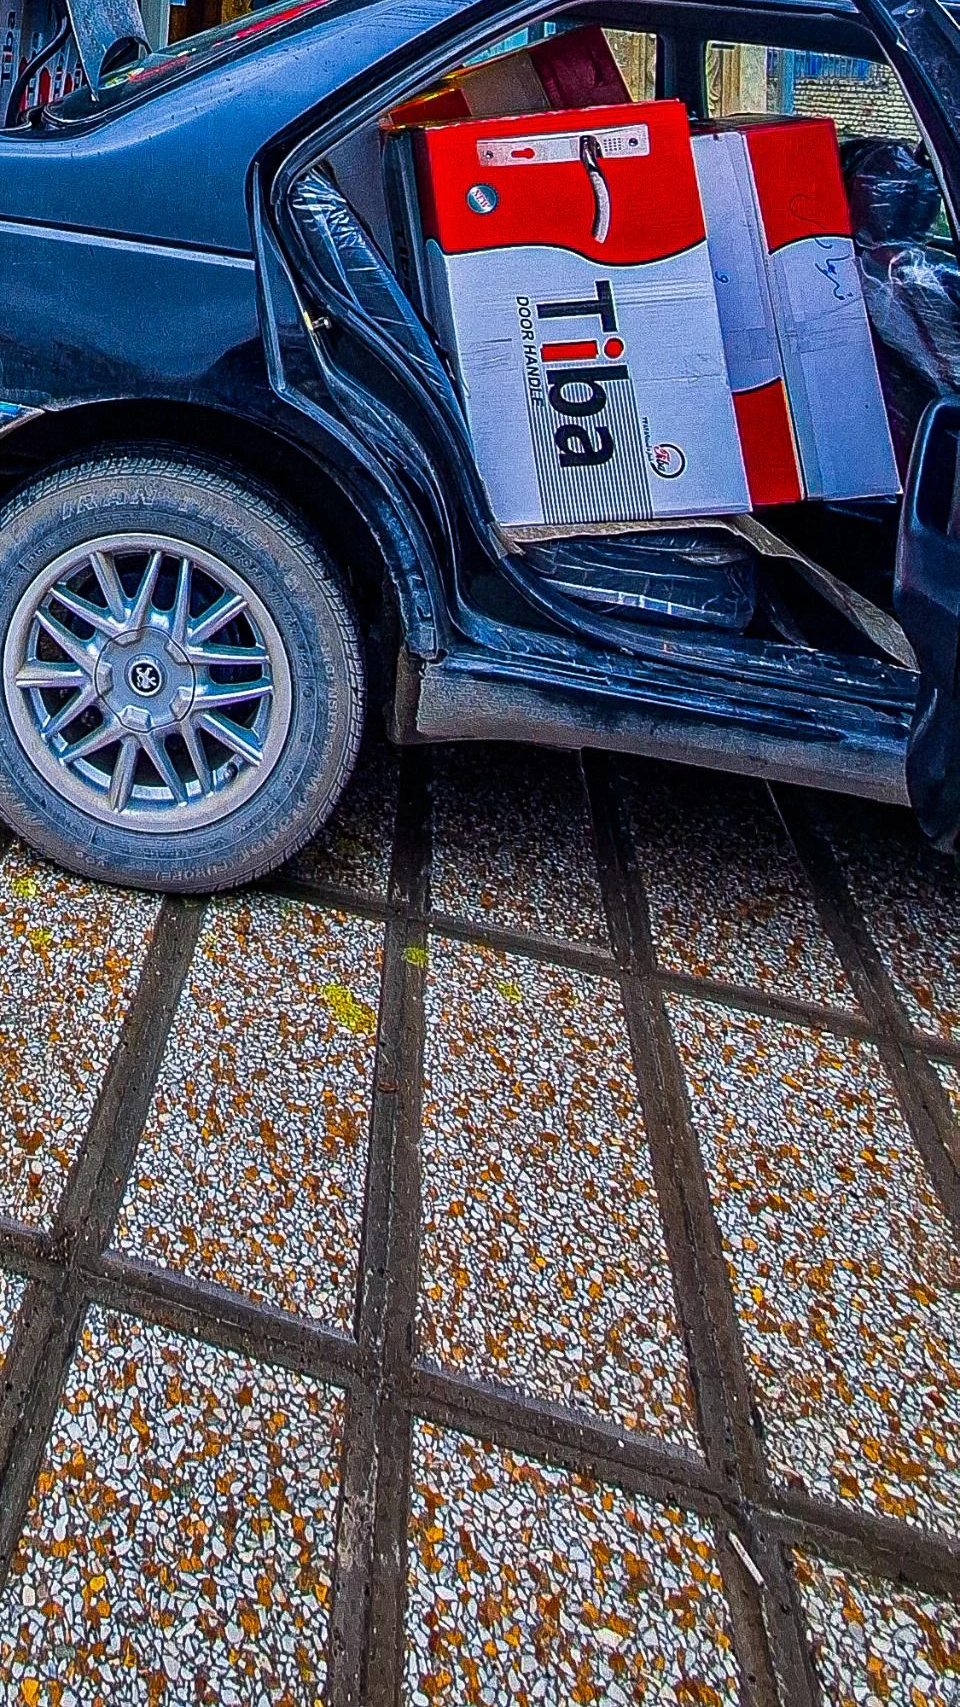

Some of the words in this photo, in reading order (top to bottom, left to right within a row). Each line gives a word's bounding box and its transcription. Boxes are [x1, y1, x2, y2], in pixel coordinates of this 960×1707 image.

[515, 295, 536, 342] DOOR
[523, 342, 544, 410] HANDLE
[536, 280, 629, 469] Tiba
[57, 488, 156, 521] IRAN
